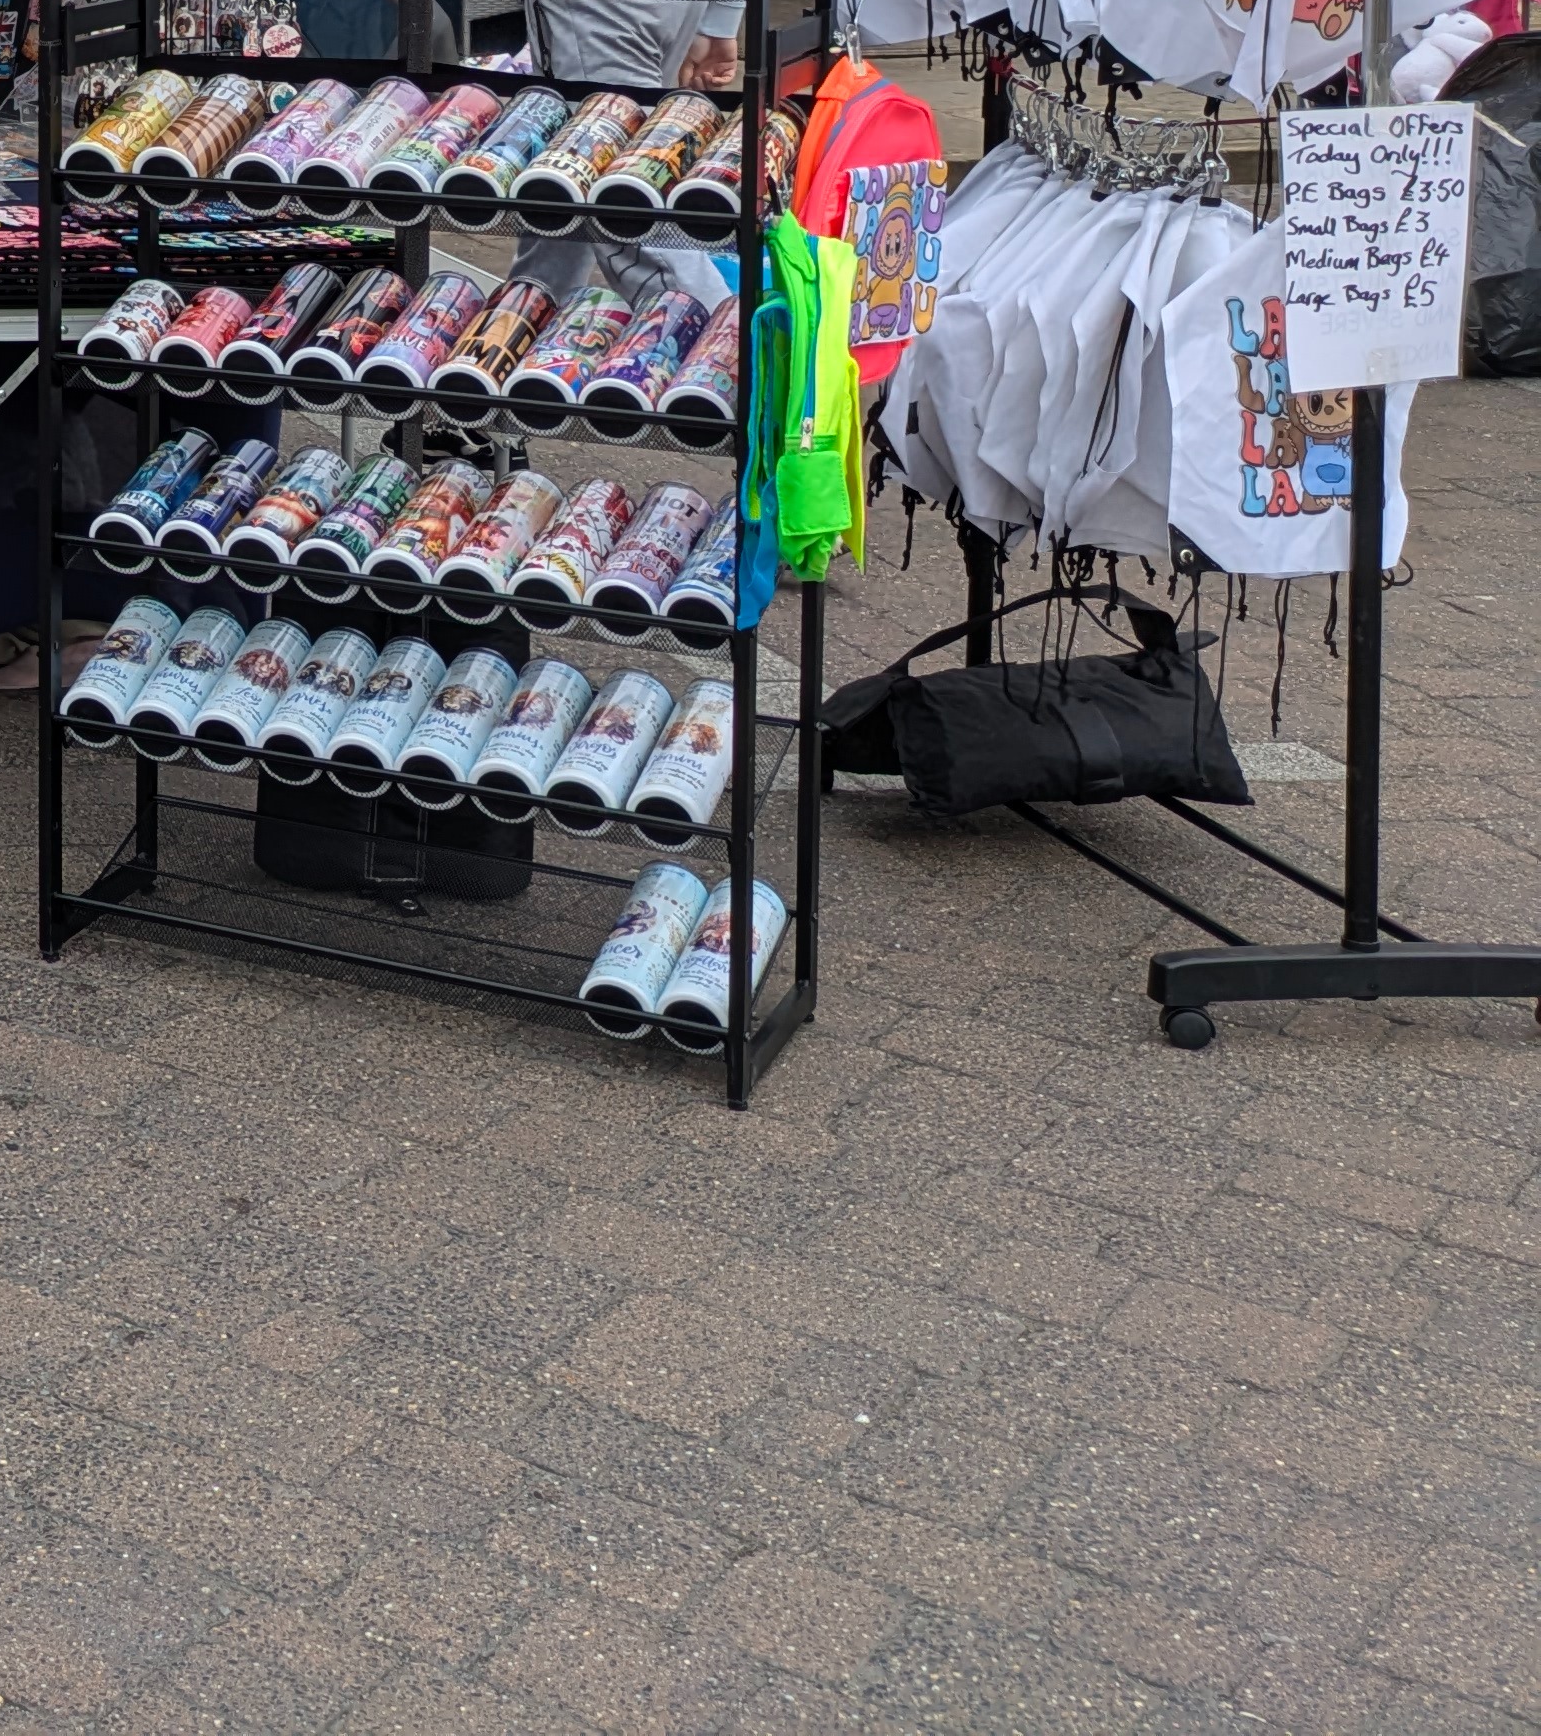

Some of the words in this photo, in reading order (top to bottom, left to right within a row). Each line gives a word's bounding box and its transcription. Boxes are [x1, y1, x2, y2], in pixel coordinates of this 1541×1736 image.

[1286, 113, 1374, 141] Special
[1287, 143, 1360, 174] Today
[1370, 137, 1453, 178] Only!!!
[1327, 182, 1385, 208] Bags
[1400, 175, 1465, 202] £3.50
[1287, 216, 1336, 236] Small
[1342, 216, 1388, 243] Bags
[1394, 207, 1430, 234] £3
[1286, 249, 1360, 270] Medium
[1365, 246, 1412, 276] Bags
[1420, 237, 1450, 267] £4
[1286, 281, 1335, 312] Large
[1343, 284, 1391, 312] Bags
[1403, 273, 1438, 308] £5
[1240, 464, 1300, 517] LA
